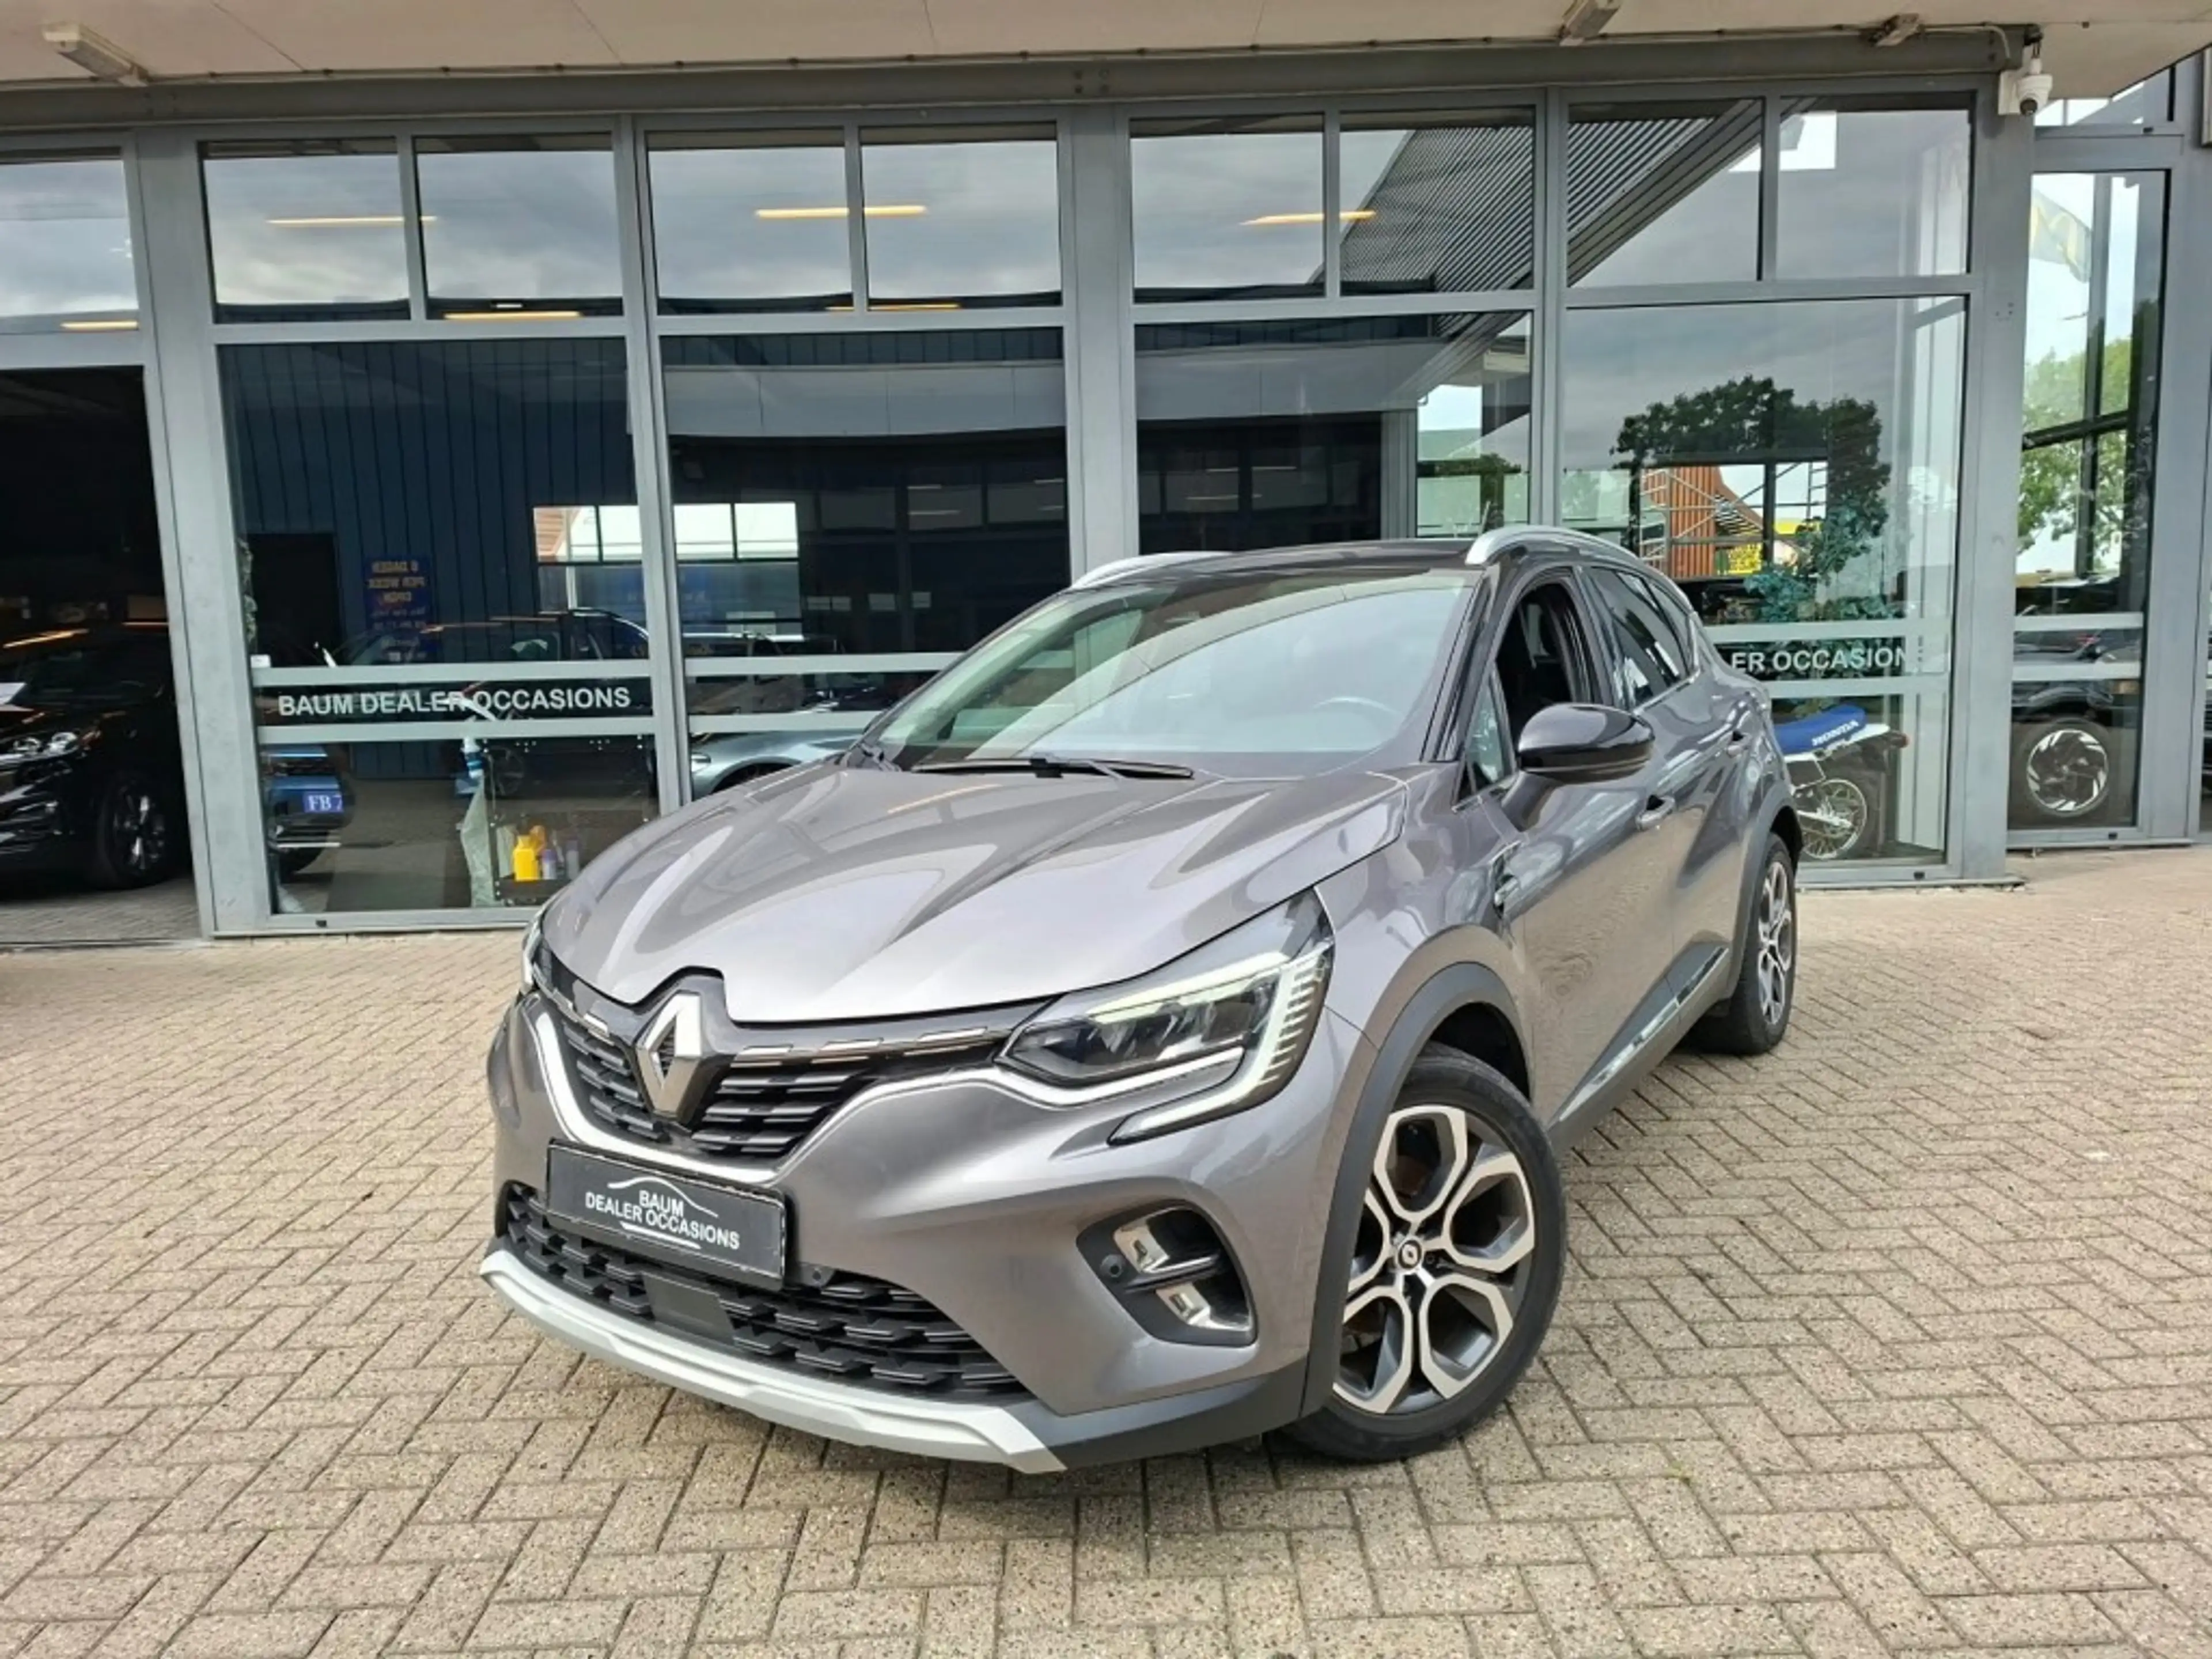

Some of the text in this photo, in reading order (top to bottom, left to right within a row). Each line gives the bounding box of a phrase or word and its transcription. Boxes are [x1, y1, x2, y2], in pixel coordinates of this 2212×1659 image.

[278, 687, 631, 716] BAUM DEALER OCCASIONS
[639, 1190, 684, 1218] BAUM
[585, 1191, 740, 1250] DEALER OCCASIONS
